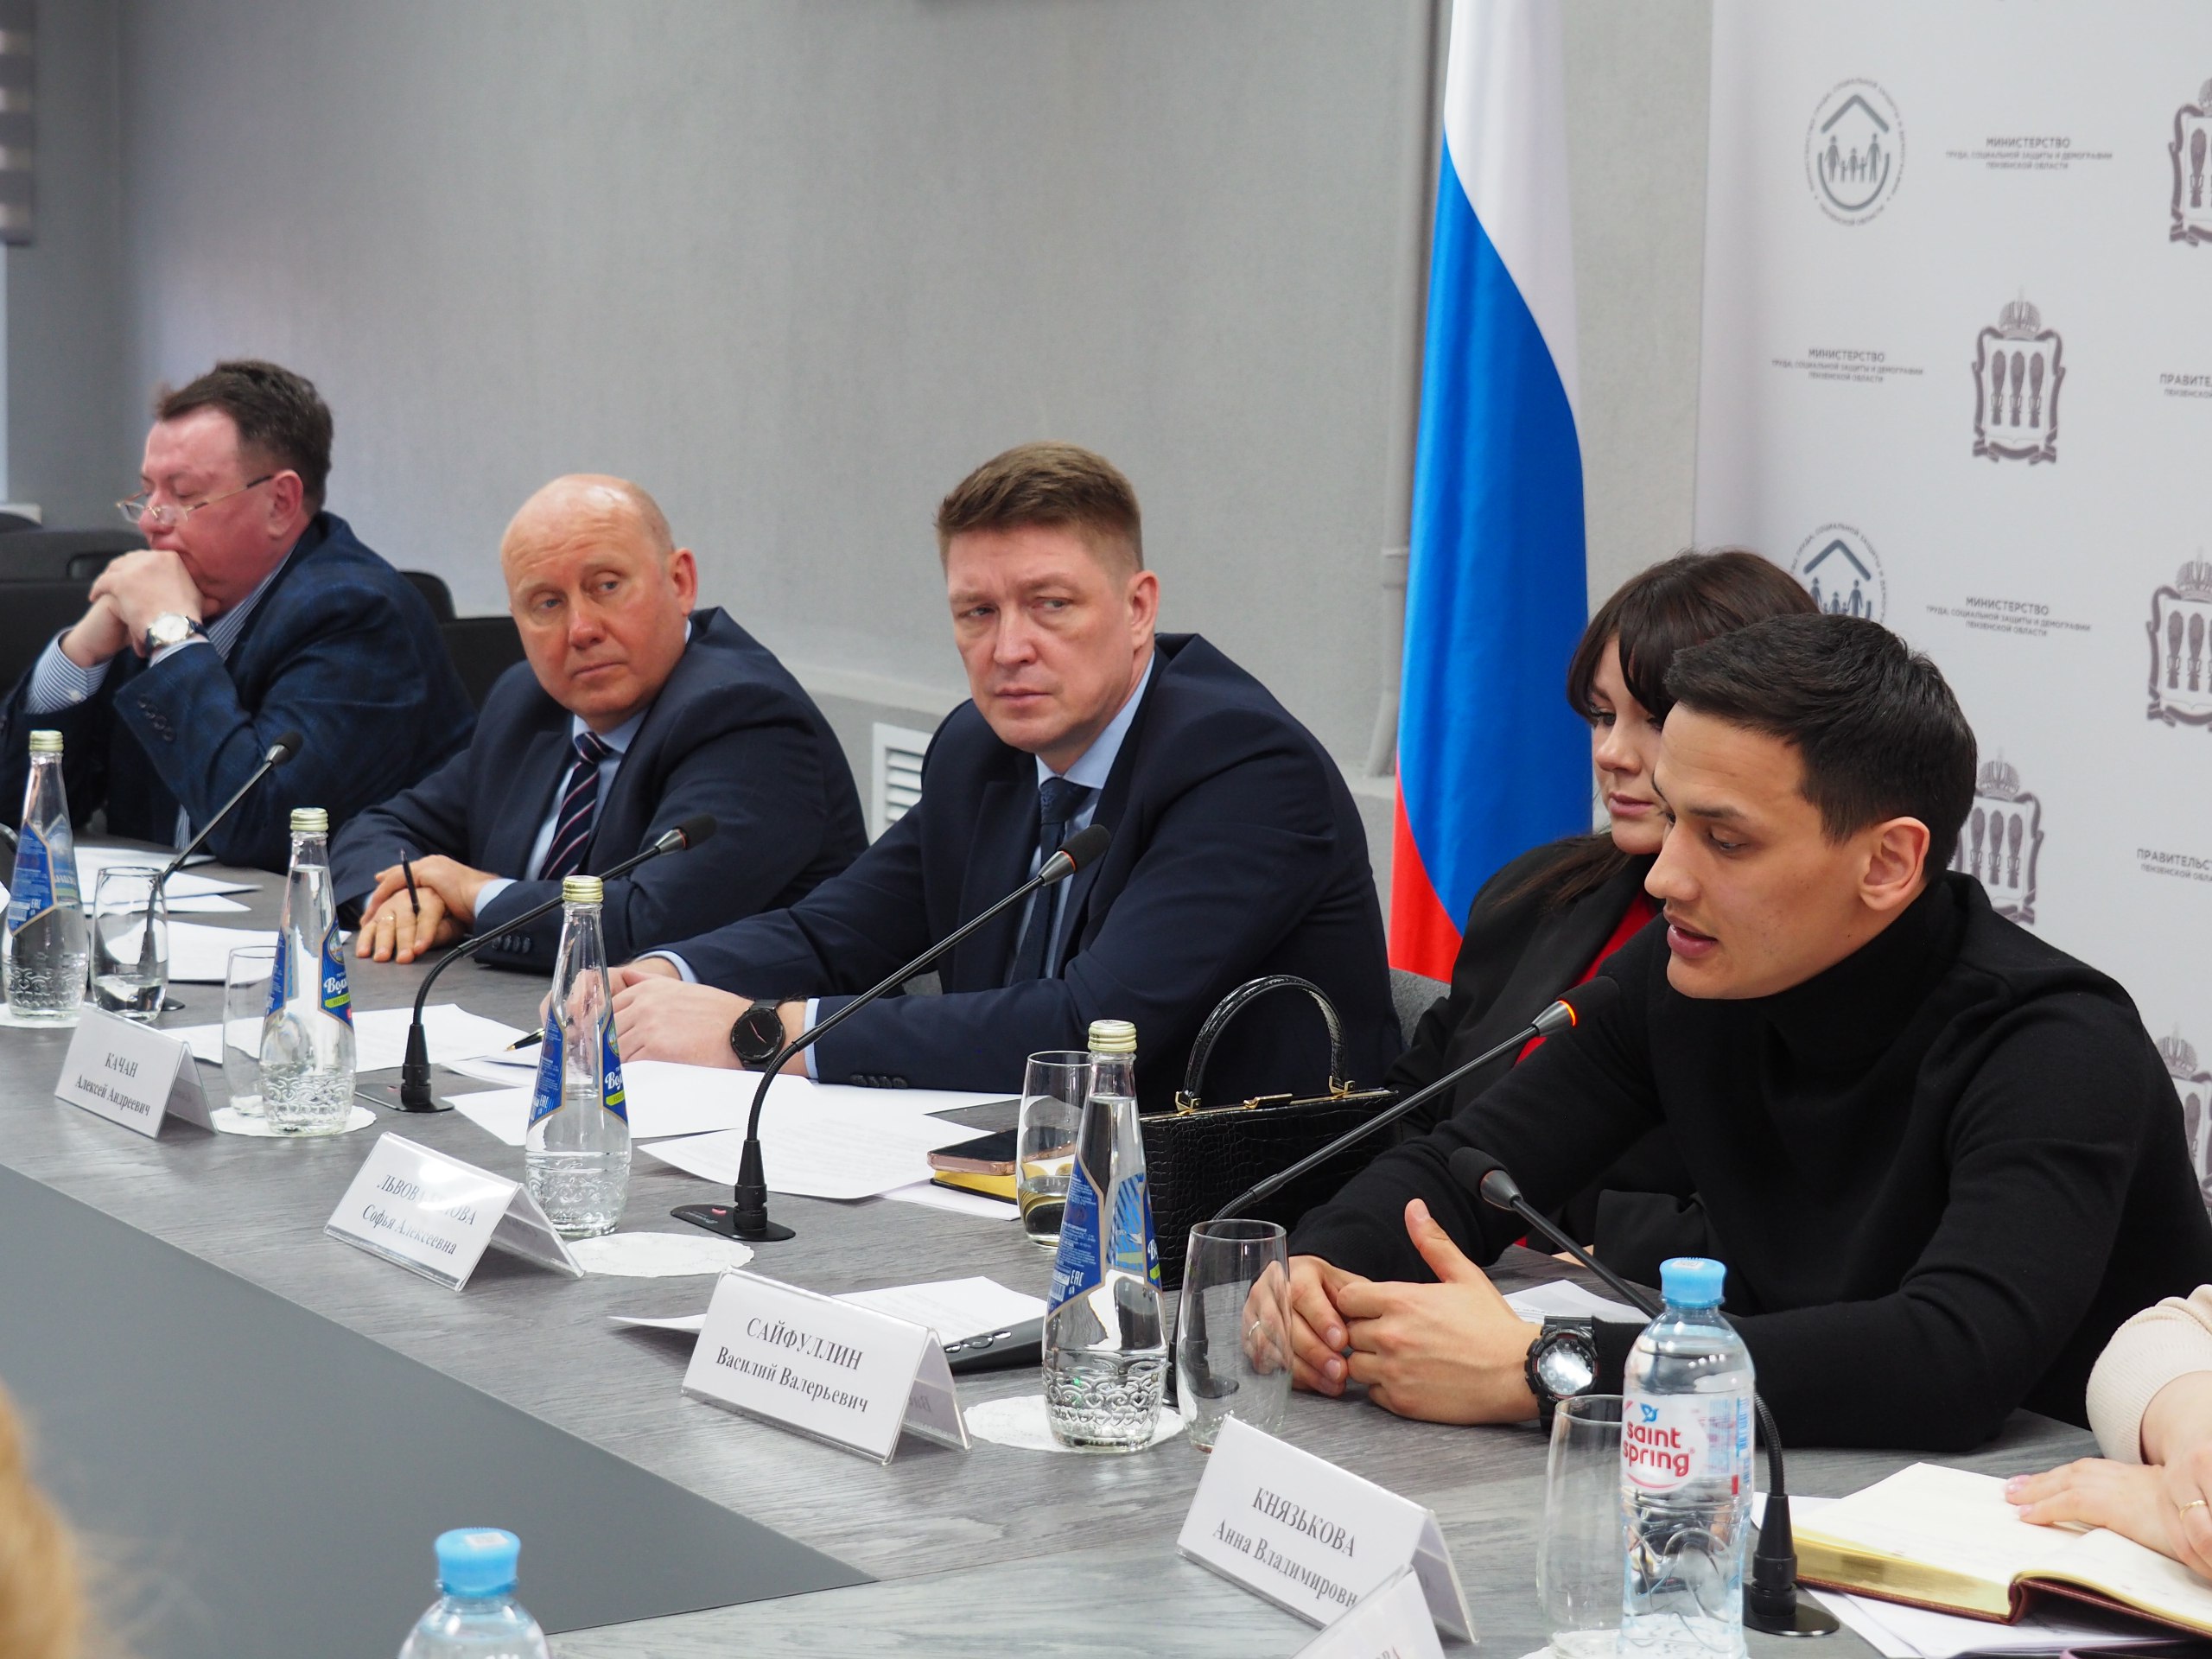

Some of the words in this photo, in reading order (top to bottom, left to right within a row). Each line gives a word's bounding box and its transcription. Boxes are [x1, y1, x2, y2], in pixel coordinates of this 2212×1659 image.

[1986, 137, 2070, 149] МИНИСТЕРСТВО
[1808, 348, 1885, 363] МИНИСТЕРСТВО
[1966, 596, 2049, 615] МИНИСТЕРСТВО
[2137, 849, 2212, 870] ПРАВИТЕЛЬС
[105, 1052, 138, 1077] КАЧАН
[75, 1075, 107, 1098] Алексей
[107, 1087, 150, 1116] Андреевич
[363, 1205, 396, 1228] Софья
[395, 1219, 457, 1255] Алексеевна
[747, 1318, 864, 1370] САЙФУЛЛИН
[715, 1346, 778, 1382] Василий
[779, 1367, 868, 1412] Валерьевич
[1627, 1421, 1681, 1448] saint
[1623, 1440, 1689, 1477] spring
[1212, 1519, 1252, 1554] Анна
[1252, 1486, 1356, 1557] КНЯЗЬКОВА
